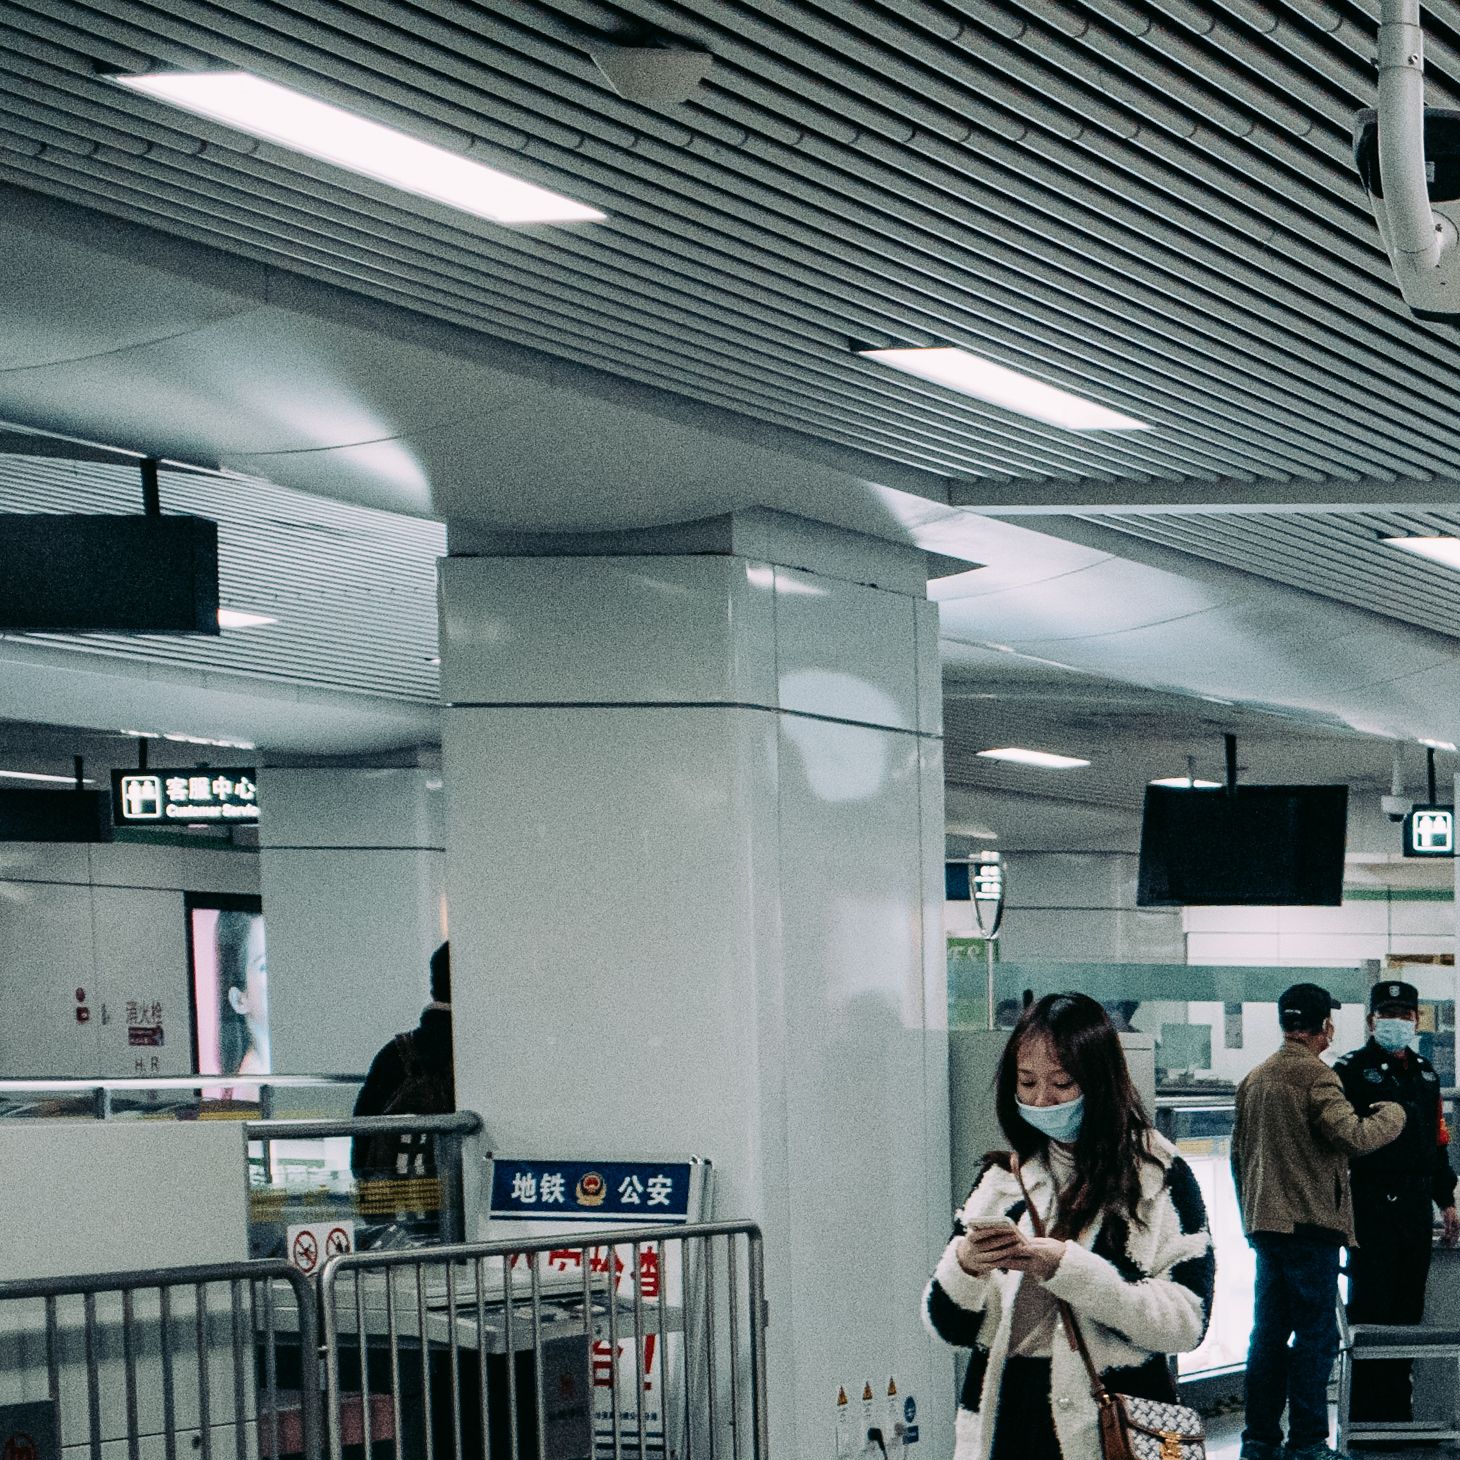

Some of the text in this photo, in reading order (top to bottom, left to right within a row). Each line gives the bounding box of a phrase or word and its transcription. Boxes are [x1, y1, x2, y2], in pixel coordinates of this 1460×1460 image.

[165, 775, 257, 802] 客服中心
[511, 1172, 673, 1206] 地铁 公安
